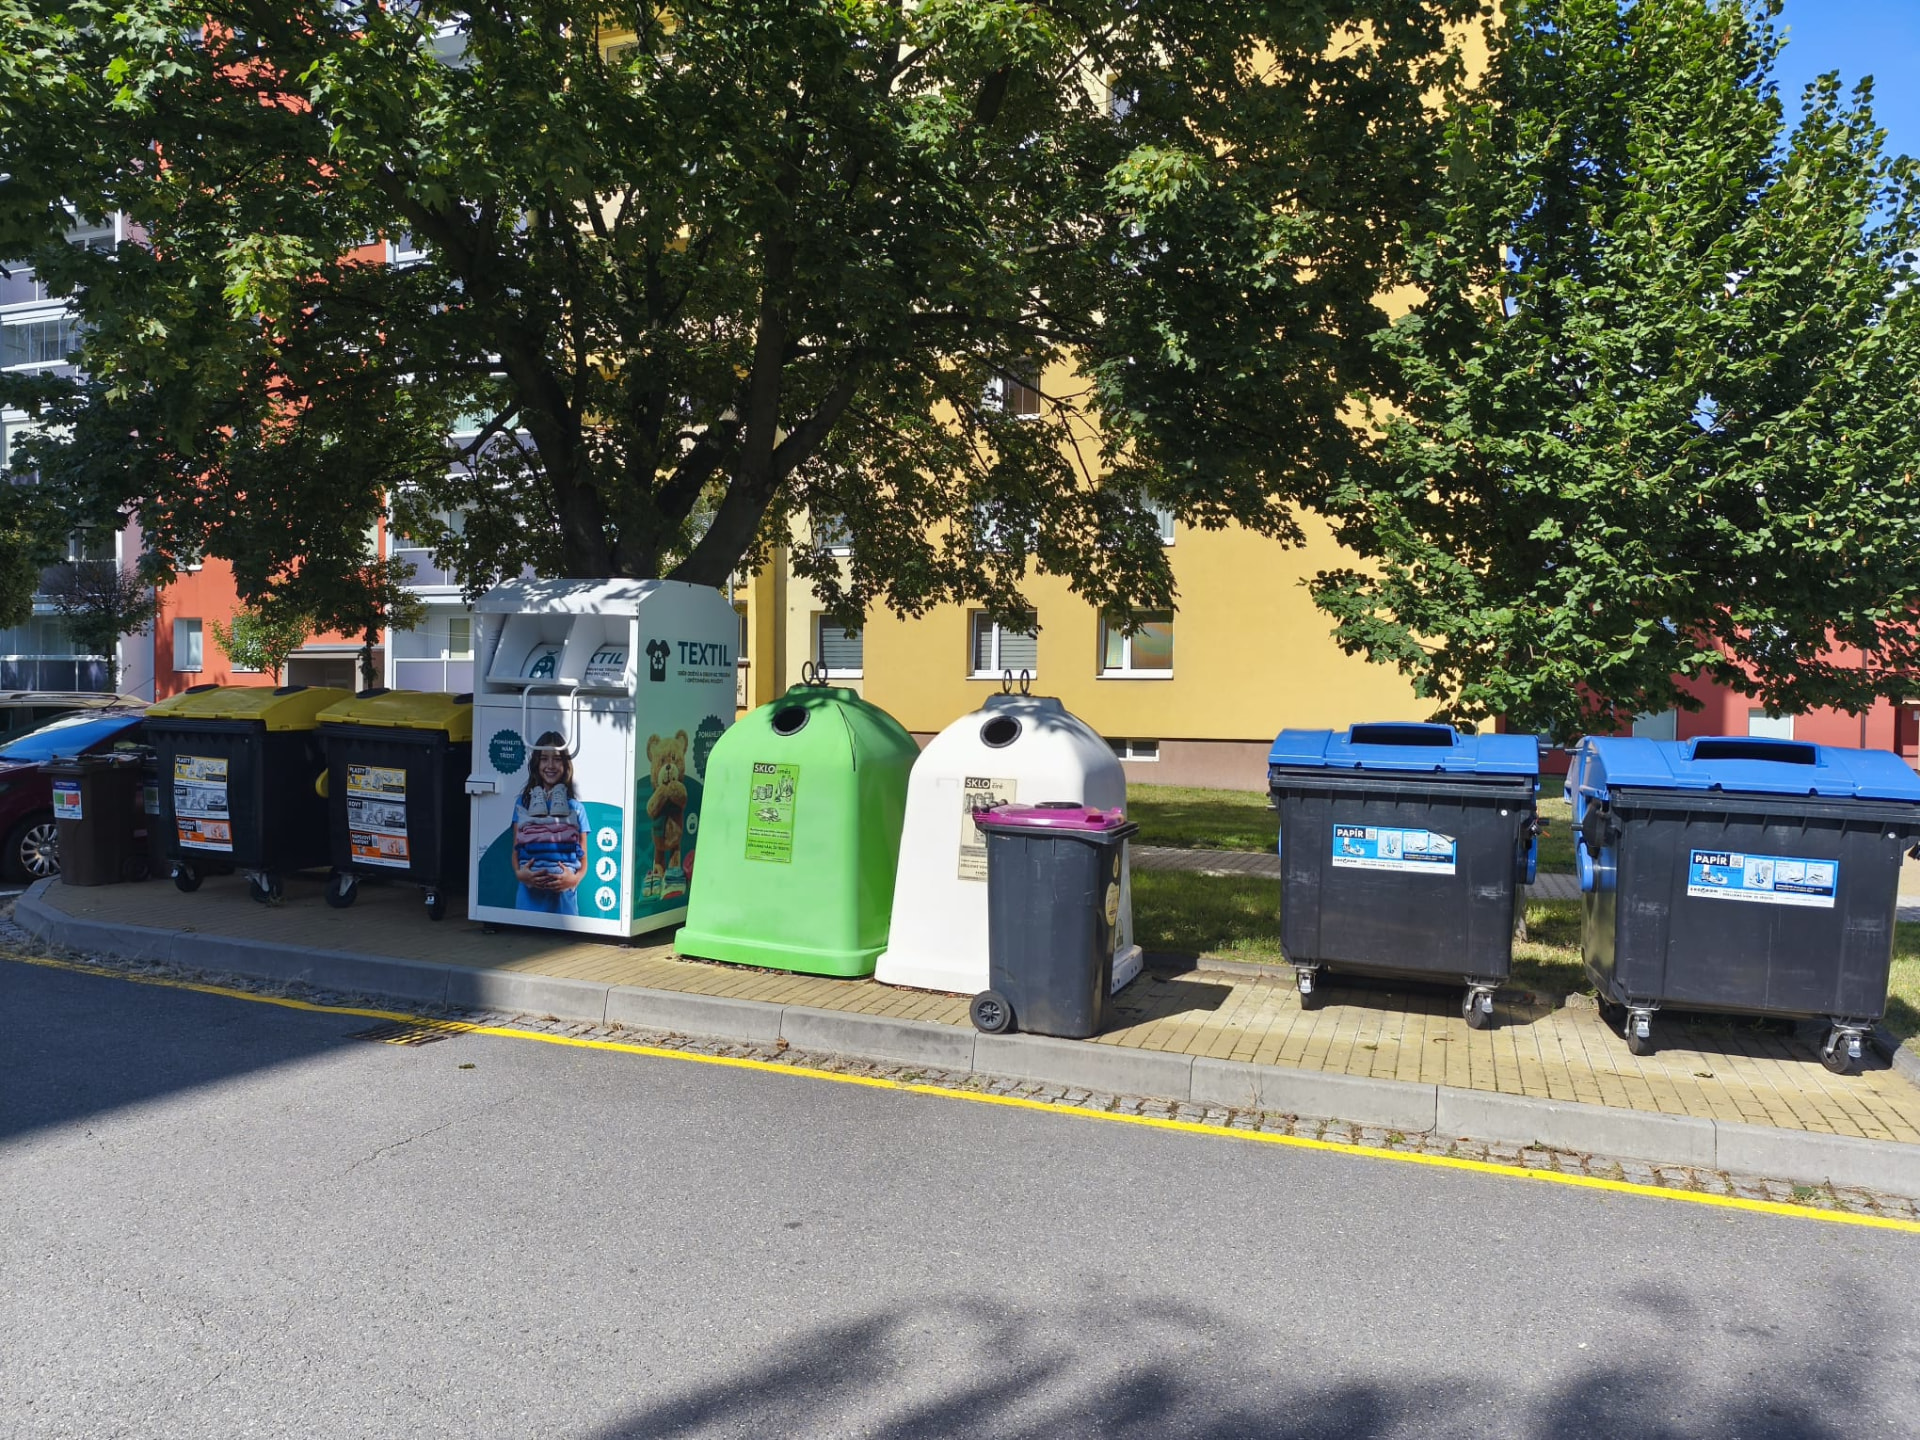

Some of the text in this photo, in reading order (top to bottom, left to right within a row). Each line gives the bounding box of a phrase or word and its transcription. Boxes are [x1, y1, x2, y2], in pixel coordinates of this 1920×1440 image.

[678, 641, 731, 666] TEXTIL
[349, 767, 365, 775] PLASTY
[754, 764, 776, 773] SKLO
[966, 778, 990, 788] SKLO
[1336, 828, 1364, 838] PAPÍR
[1695, 854, 1727, 866] PAPÍR
